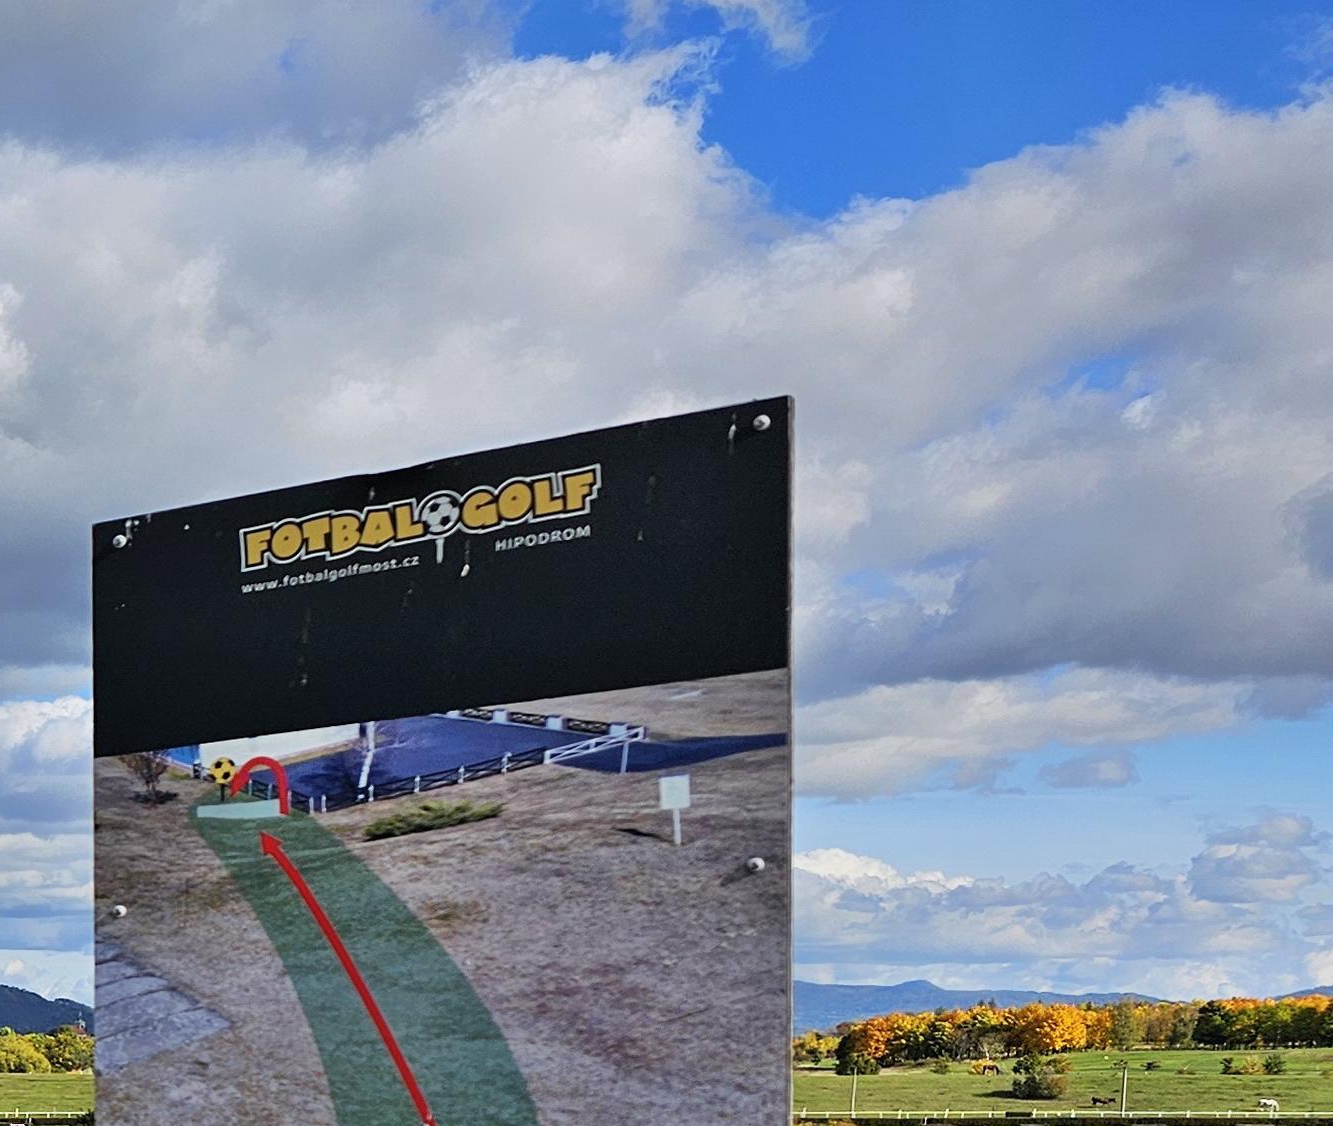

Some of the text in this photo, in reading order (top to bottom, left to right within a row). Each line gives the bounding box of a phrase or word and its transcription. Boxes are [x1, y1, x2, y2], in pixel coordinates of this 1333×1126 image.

[242, 469, 598, 569] FOTBAL GOLF
[494, 525, 592, 552] HIPODROM
[241, 555, 421, 594] www.fotbalgolfmost.cz
